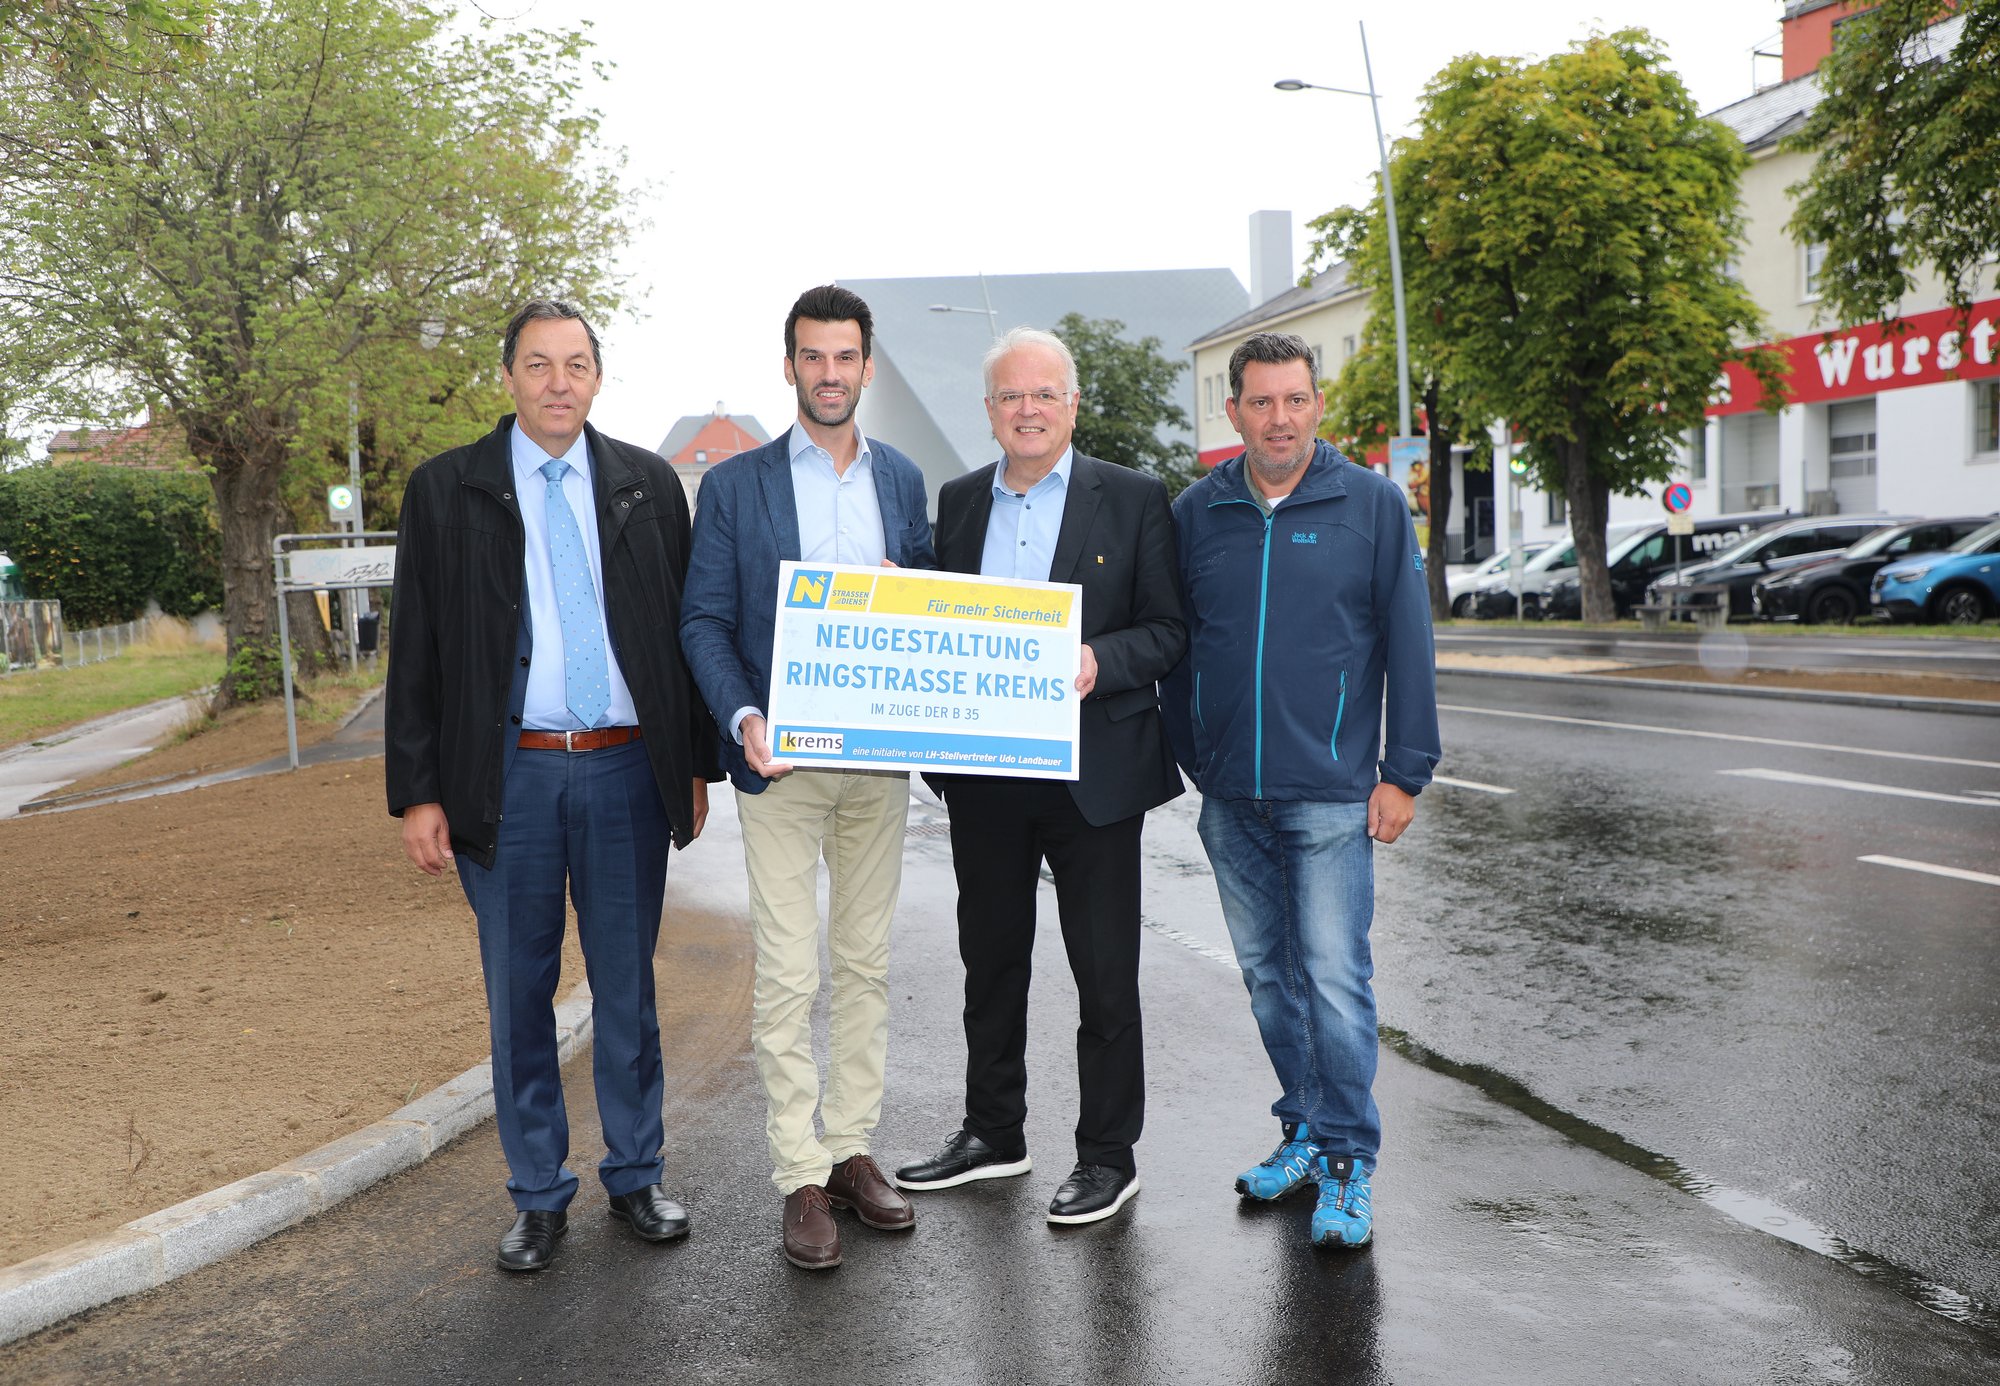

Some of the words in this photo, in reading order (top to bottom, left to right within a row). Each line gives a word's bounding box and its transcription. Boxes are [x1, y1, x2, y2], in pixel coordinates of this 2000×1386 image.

[1813, 316, 1997, 389] Wurst
[832, 590, 869, 599] STRASSEN
[841, 598, 867, 606] DIENST
[927, 600, 951, 613] Für
[953, 603, 990, 616] mehr
[992, 605, 1062, 623] Sicherheit
[816, 624, 1040, 662] NEUGESTALTUNG
[786, 661, 967, 694] RINGSTRASSE
[976, 672, 1065, 701] KREMS
[870, 703, 885, 715] IM
[888, 704, 921, 717] ZUGE
[924, 706, 948, 718] DER
[952, 708, 960, 719] B
[964, 708, 980, 720] 35
[786, 732, 843, 749] krems
[852, 746, 870, 756] eine
[871, 747, 907, 758] Initiative
[925, 750, 997, 762] LH-Stellvertreter
[999, 754, 1016, 763] Udo
[1018, 755, 1063, 766] Landbauer
